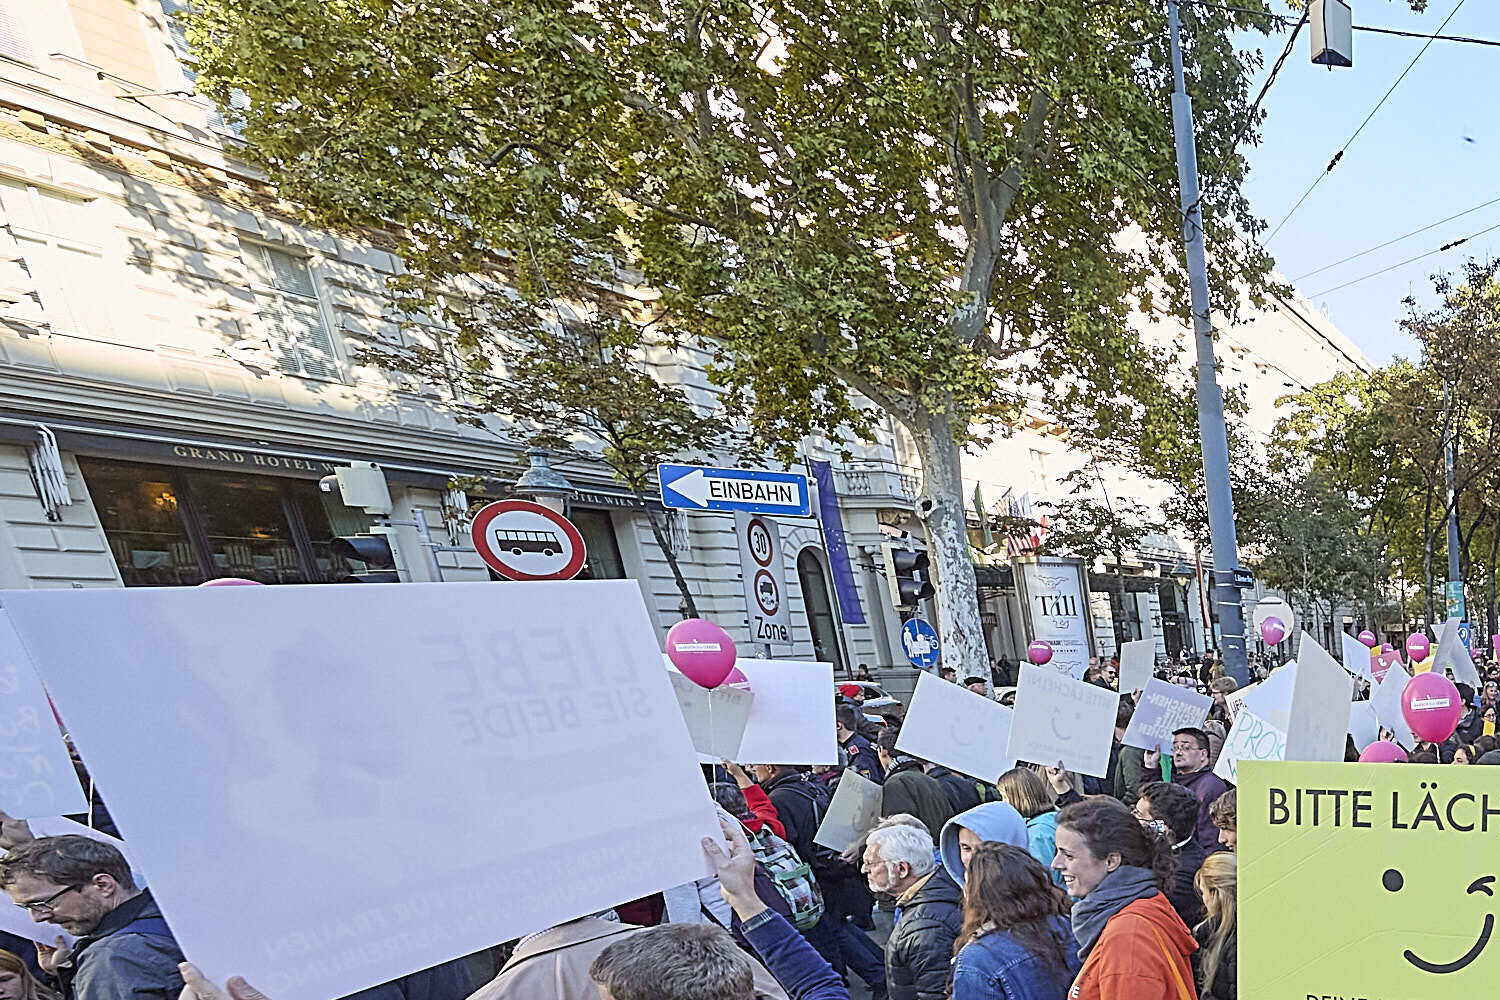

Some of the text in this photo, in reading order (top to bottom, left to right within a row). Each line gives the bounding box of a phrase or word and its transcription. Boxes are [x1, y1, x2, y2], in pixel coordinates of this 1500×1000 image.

[173, 445, 245, 463] GRAND
[253, 454, 317, 472] HOTEL
[709, 480, 793, 503] EINBAHN
[753, 532, 768, 555] 30
[1035, 594, 1079, 617] Till
[754, 616, 788, 640] Zone
[1269, 788, 1373, 829] BITTE
